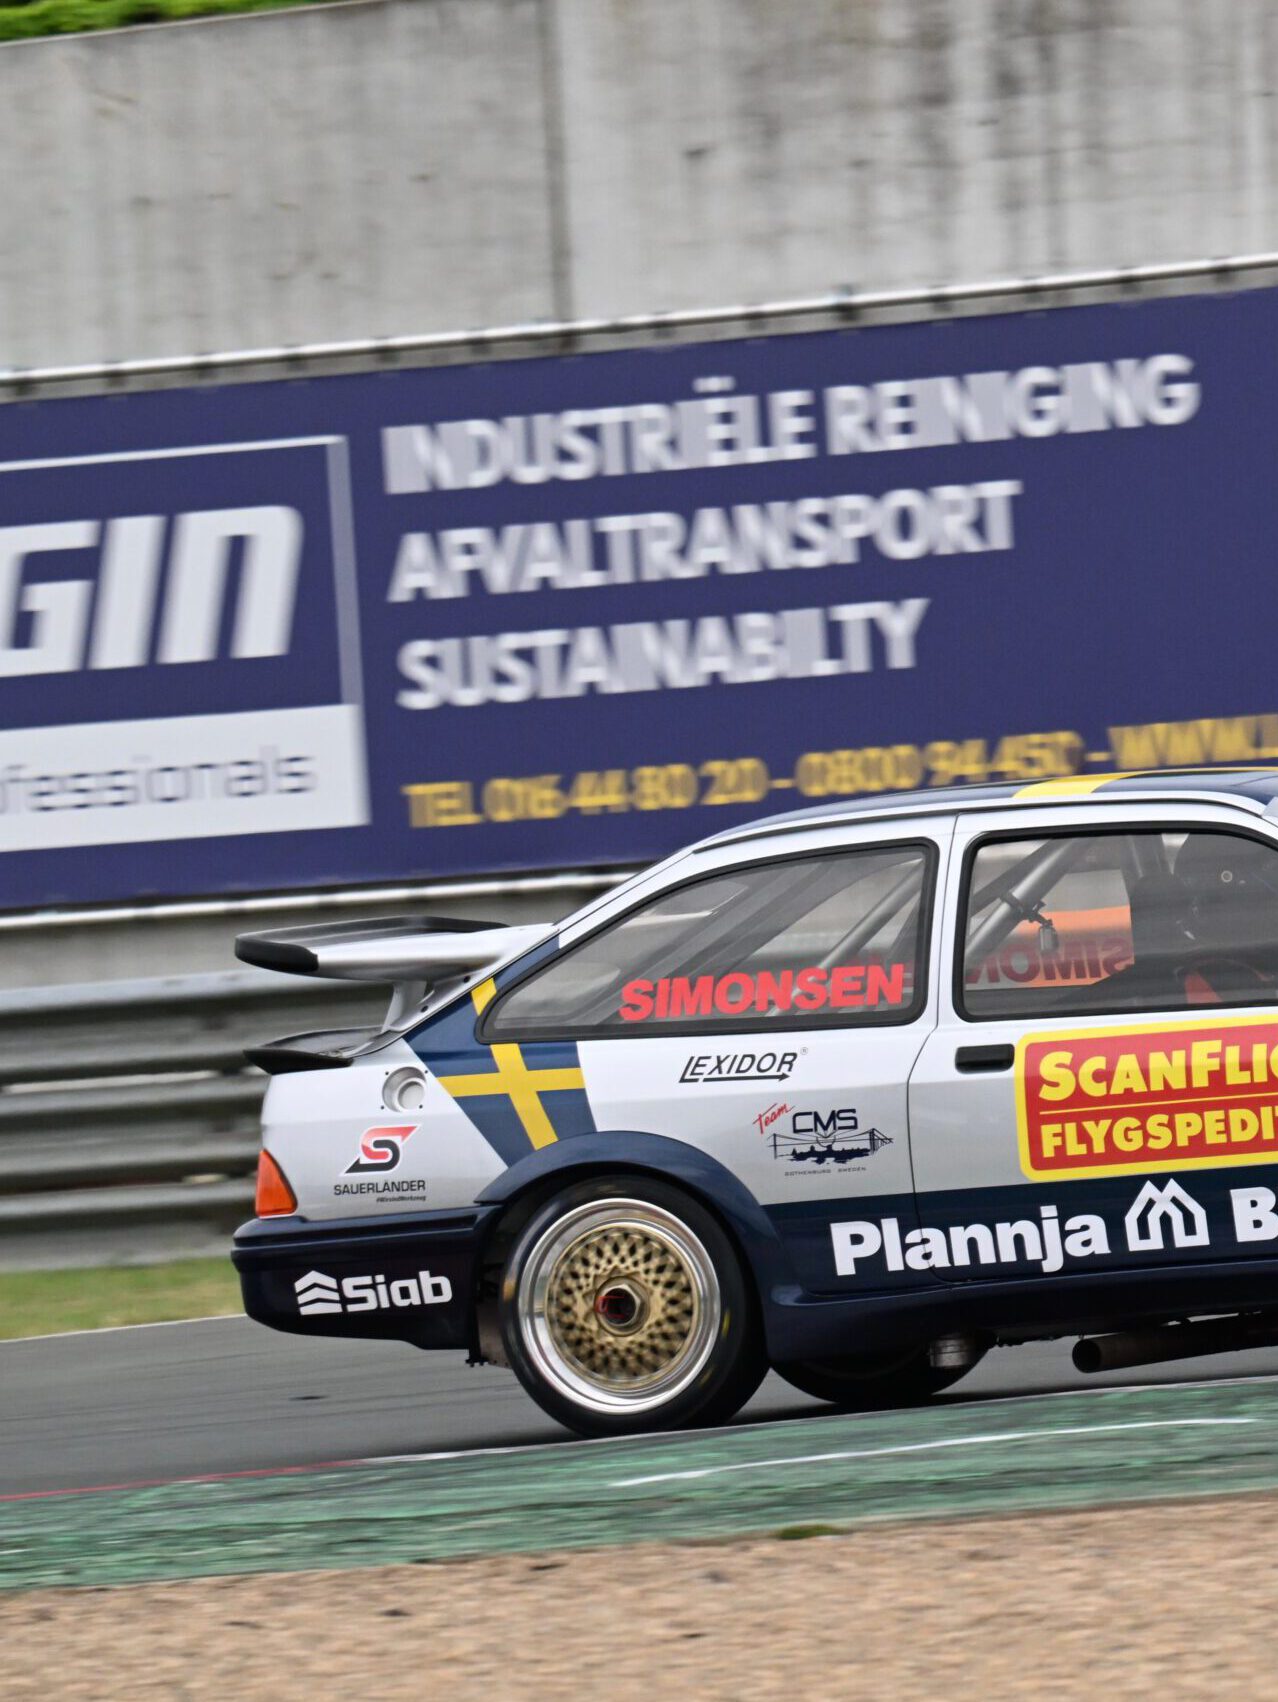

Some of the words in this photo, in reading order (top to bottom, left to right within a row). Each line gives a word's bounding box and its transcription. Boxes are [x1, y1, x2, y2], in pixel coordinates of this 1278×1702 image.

[380, 375, 817, 495] INDUSTRIËLE
[823, 353, 1201, 456] REINIGING
[387, 479, 1023, 602] AFVALTRANSPORT
[0, 744, 318, 815] fessionals
[618, 962, 905, 1022] SIMONSEN
[678, 1051, 799, 1084] LEXIDOR
[752, 1102, 796, 1136] Team
[791, 1108, 859, 1134] CMS
[828, 1204, 1112, 1275] Plannja
[341, 1269, 453, 1313] Siab
